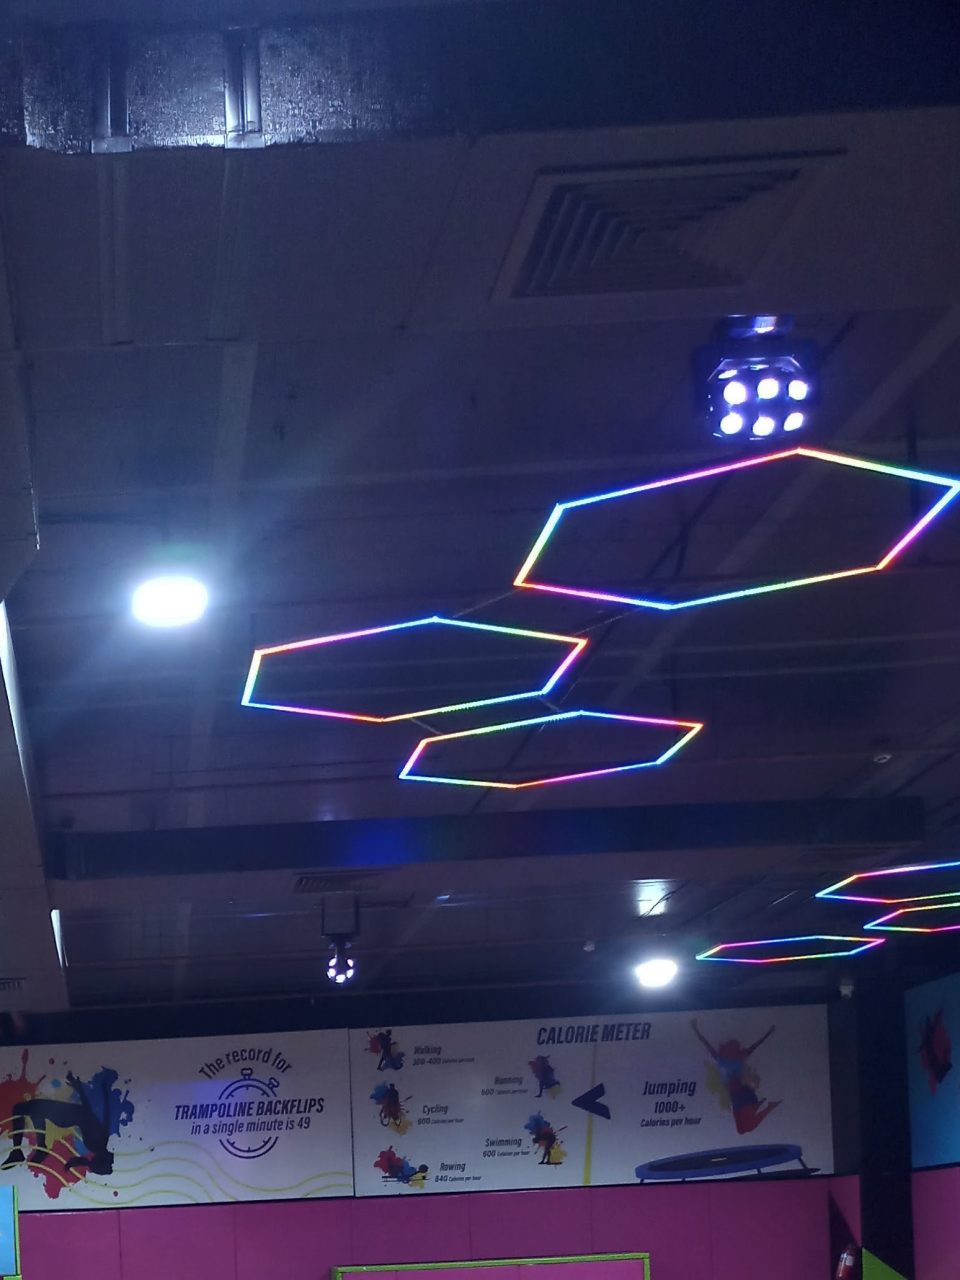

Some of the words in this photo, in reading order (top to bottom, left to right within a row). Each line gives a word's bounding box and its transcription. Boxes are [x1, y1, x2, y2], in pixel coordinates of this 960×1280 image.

[536, 1024, 600, 1046] CALORIE
[601, 1022, 651, 1042] METER
[198, 1057, 226, 1080] The
[225, 1048, 273, 1067] record
[273, 1051, 293, 1074] for
[641, 1079, 697, 1098] Jumping
[175, 1101, 255, 1121] TRAMPOLINE
[256, 1097, 325, 1116] BACKFLIPS
[422, 1104, 449, 1116] Cycling
[654, 1100, 686, 1114] 1000+
[191, 1122, 201, 1136] in
[203, 1124, 210, 1134] a
[211, 1120, 244, 1136] single
[245, 1117, 283, 1133] minute
[285, 1117, 295, 1131] is
[297, 1116, 311, 1129] 49
[485, 1138, 522, 1148] Swimming
[440, 1162, 466, 1172] Rowing
